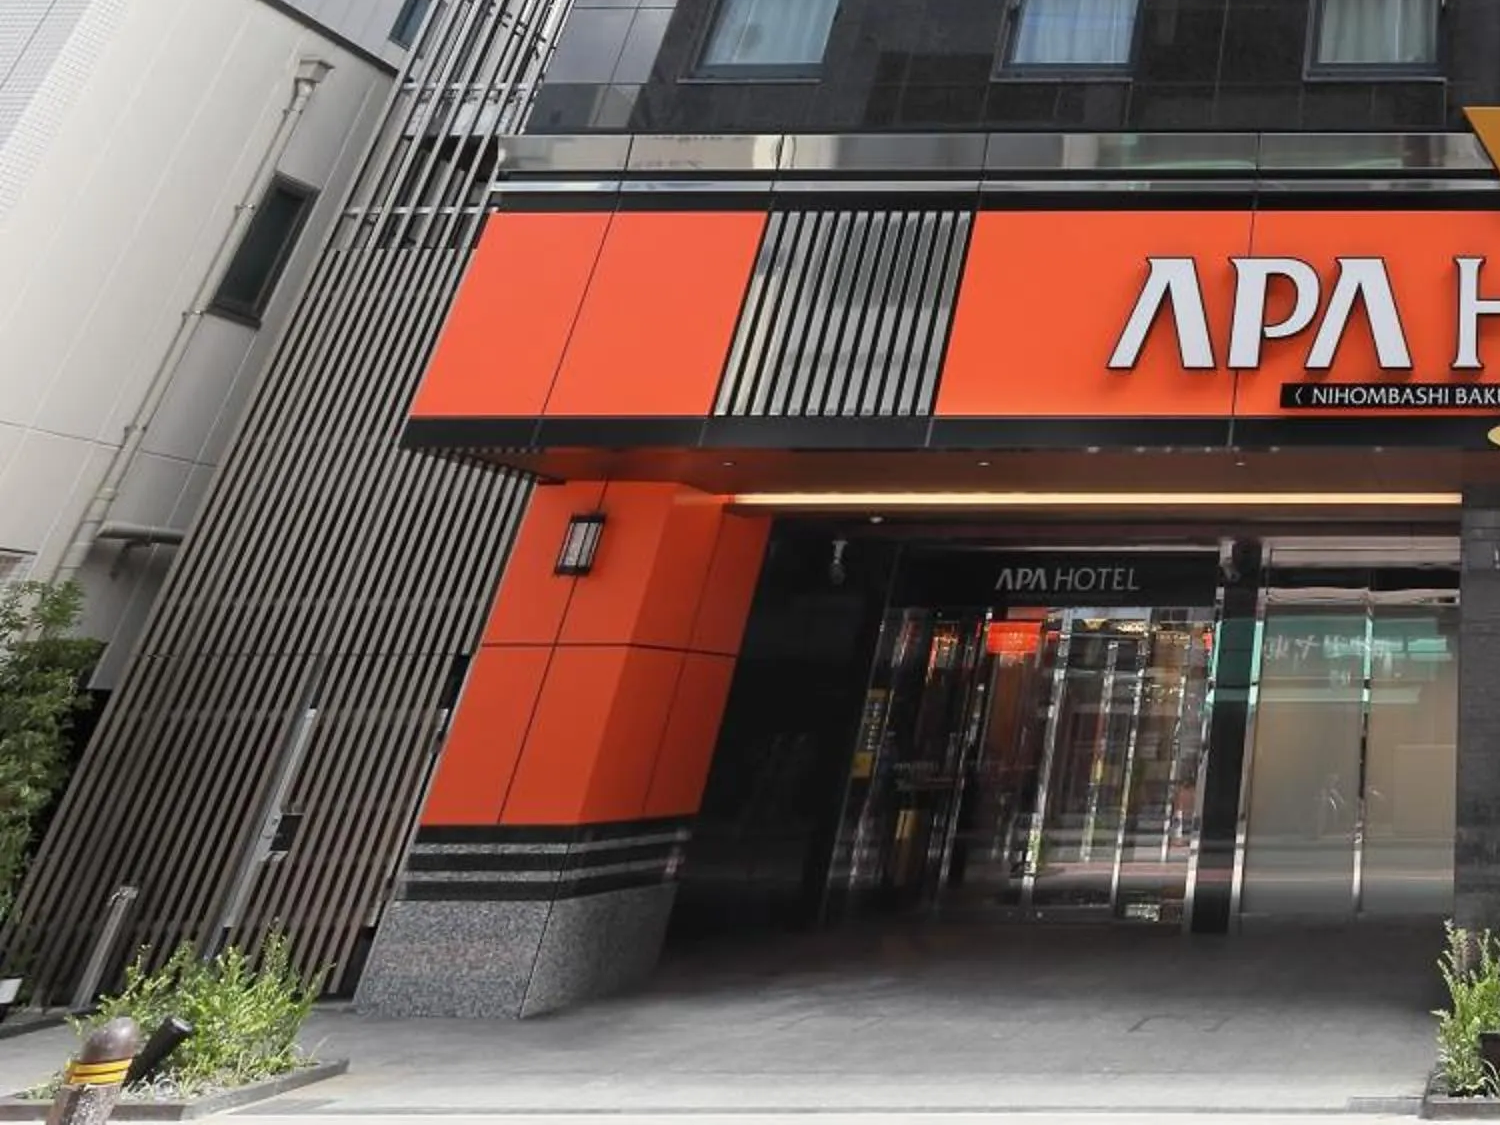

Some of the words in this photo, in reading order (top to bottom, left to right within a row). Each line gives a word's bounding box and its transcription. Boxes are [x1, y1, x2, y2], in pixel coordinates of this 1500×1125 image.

[1106, 256, 1414, 370] APA
[1311, 386, 1450, 405] NIHOMBASHI
[994, 568, 1048, 591] APA
[1053, 567, 1140, 591] HOTEL
